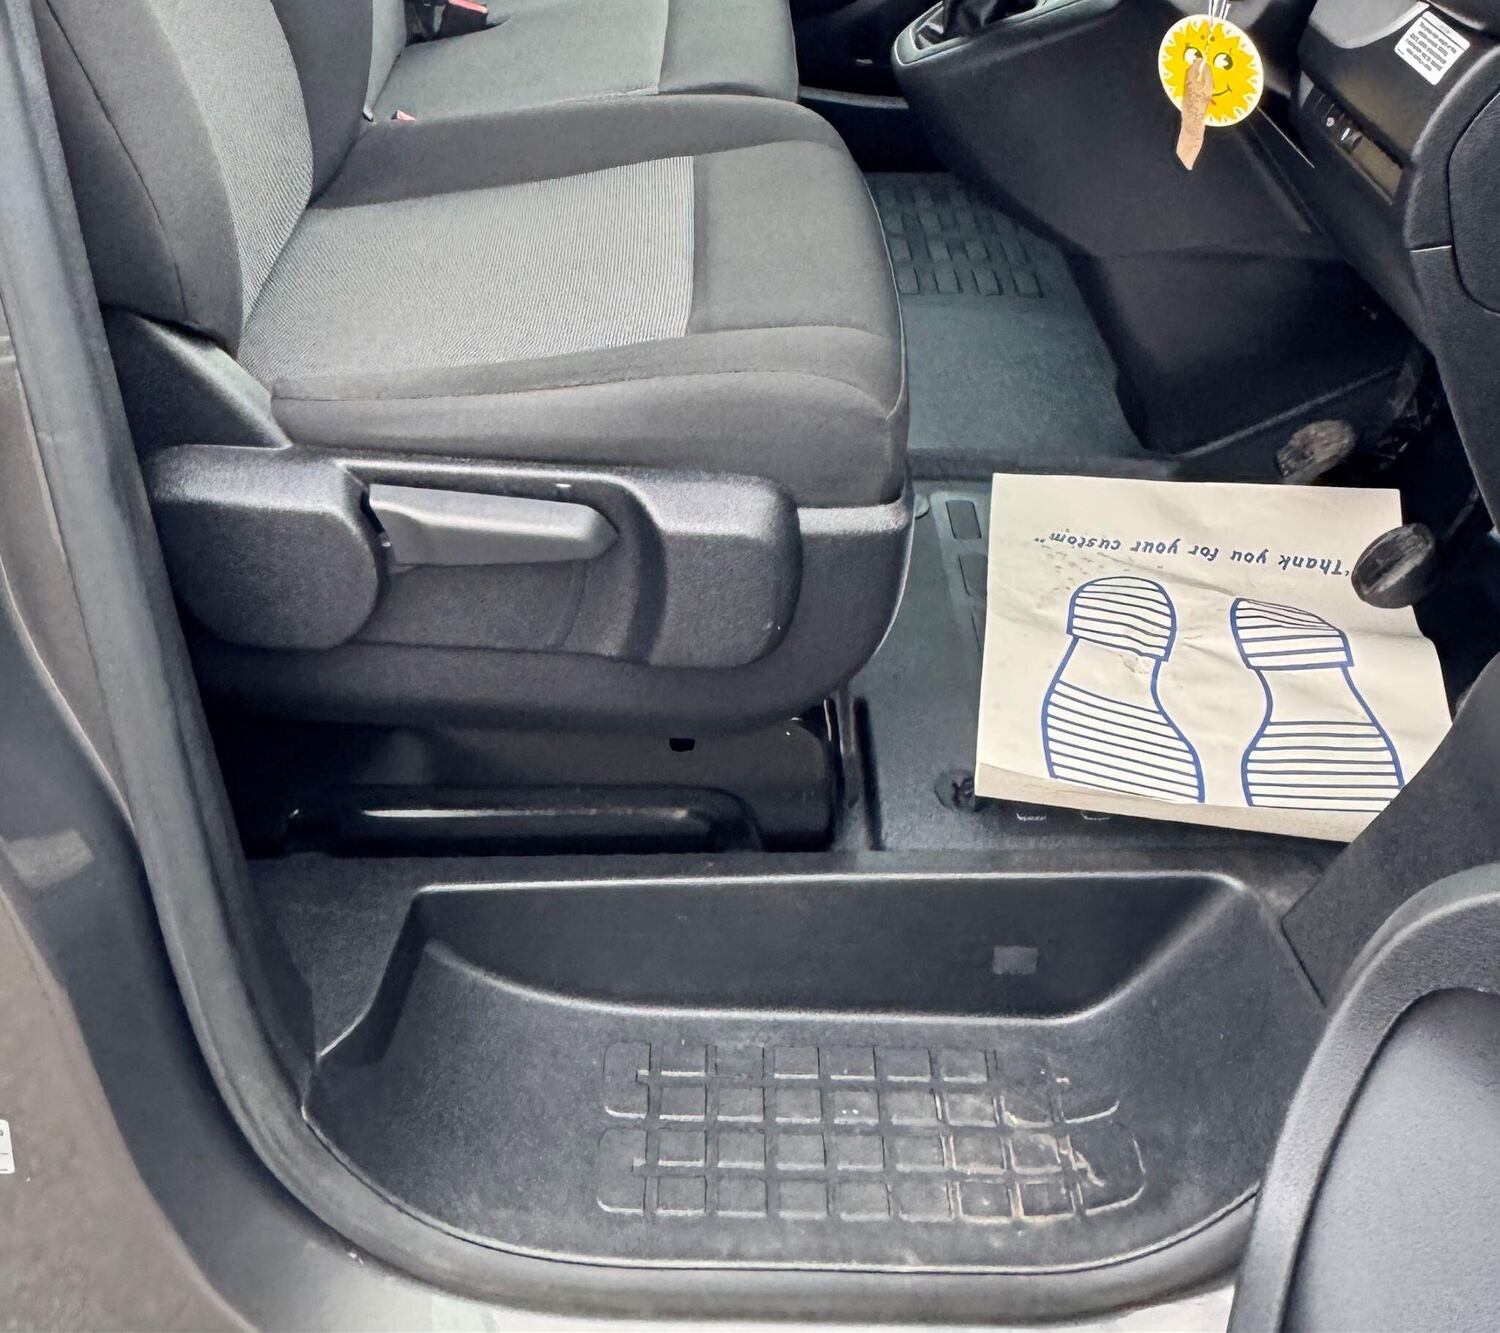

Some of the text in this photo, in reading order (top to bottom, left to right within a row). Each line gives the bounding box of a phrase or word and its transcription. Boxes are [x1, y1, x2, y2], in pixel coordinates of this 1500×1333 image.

[1130, 538, 1182, 555] your
[1187, 544, 1220, 563] for
[1230, 548, 1269, 565] you
